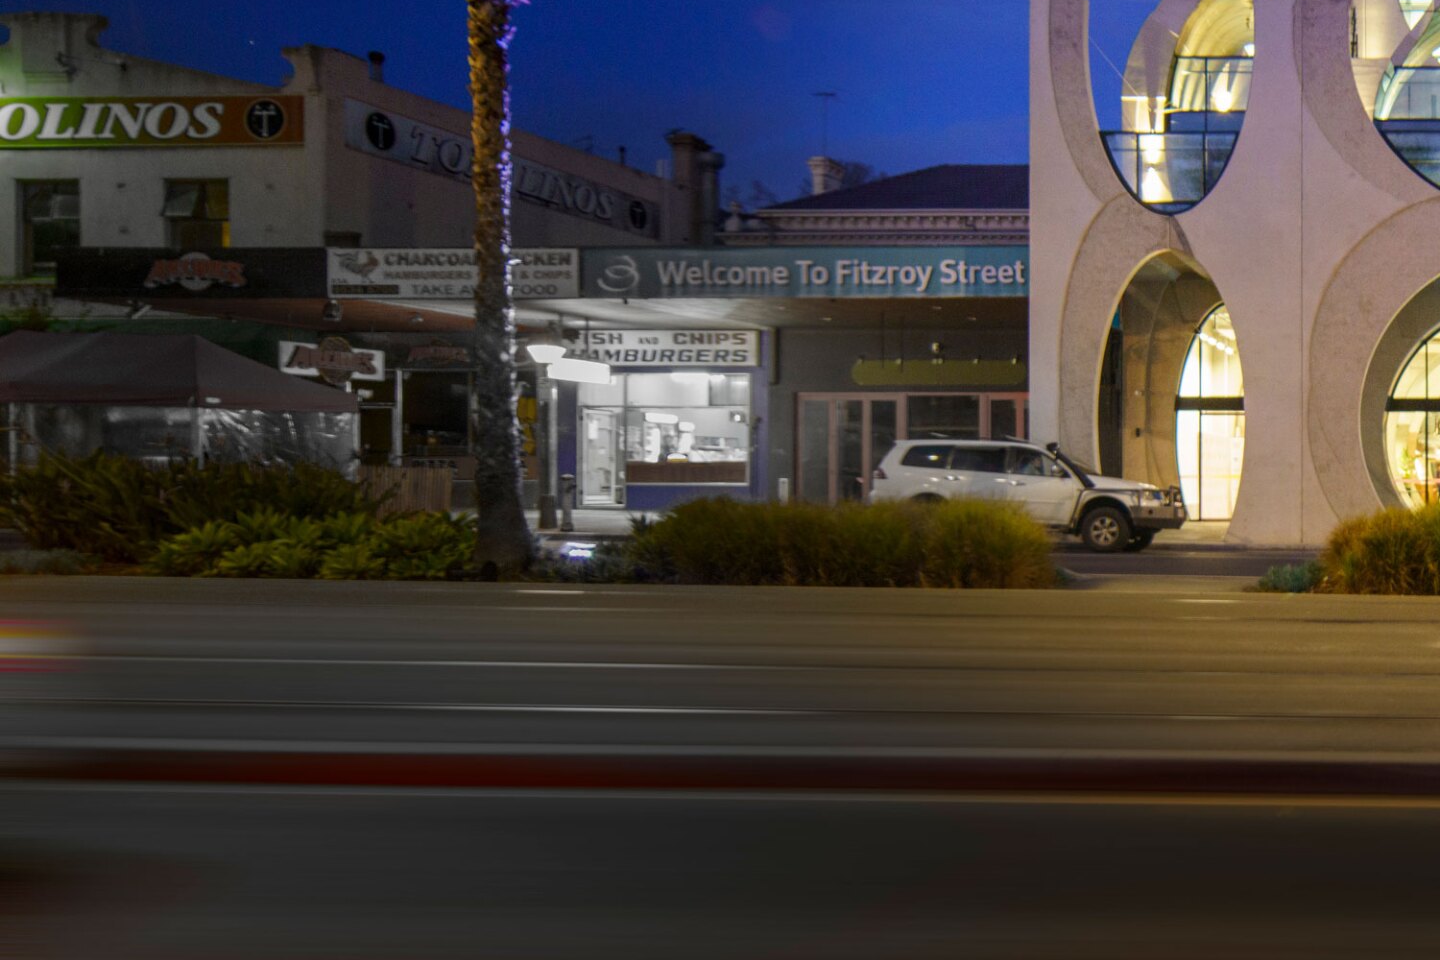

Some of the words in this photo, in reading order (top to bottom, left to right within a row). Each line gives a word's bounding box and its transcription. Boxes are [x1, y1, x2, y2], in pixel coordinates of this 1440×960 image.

[411, 125, 615, 221] TOLINOS
[383, 270, 473, 280] HAMBURGERS
[533, 270, 572, 280] CHIPS
[656, 260, 789, 285] Welcome
[795, 259, 828, 285] To
[836, 258, 933, 292] Fitzroy
[939, 258, 1025, 285] Street
[411, 284, 455, 295] TAKE
[569, 332, 623, 345] ISH
[638, 337, 659, 345] AND
[672, 332, 747, 345] CHIPS
[569, 349, 749, 362] HAMBURGERS
